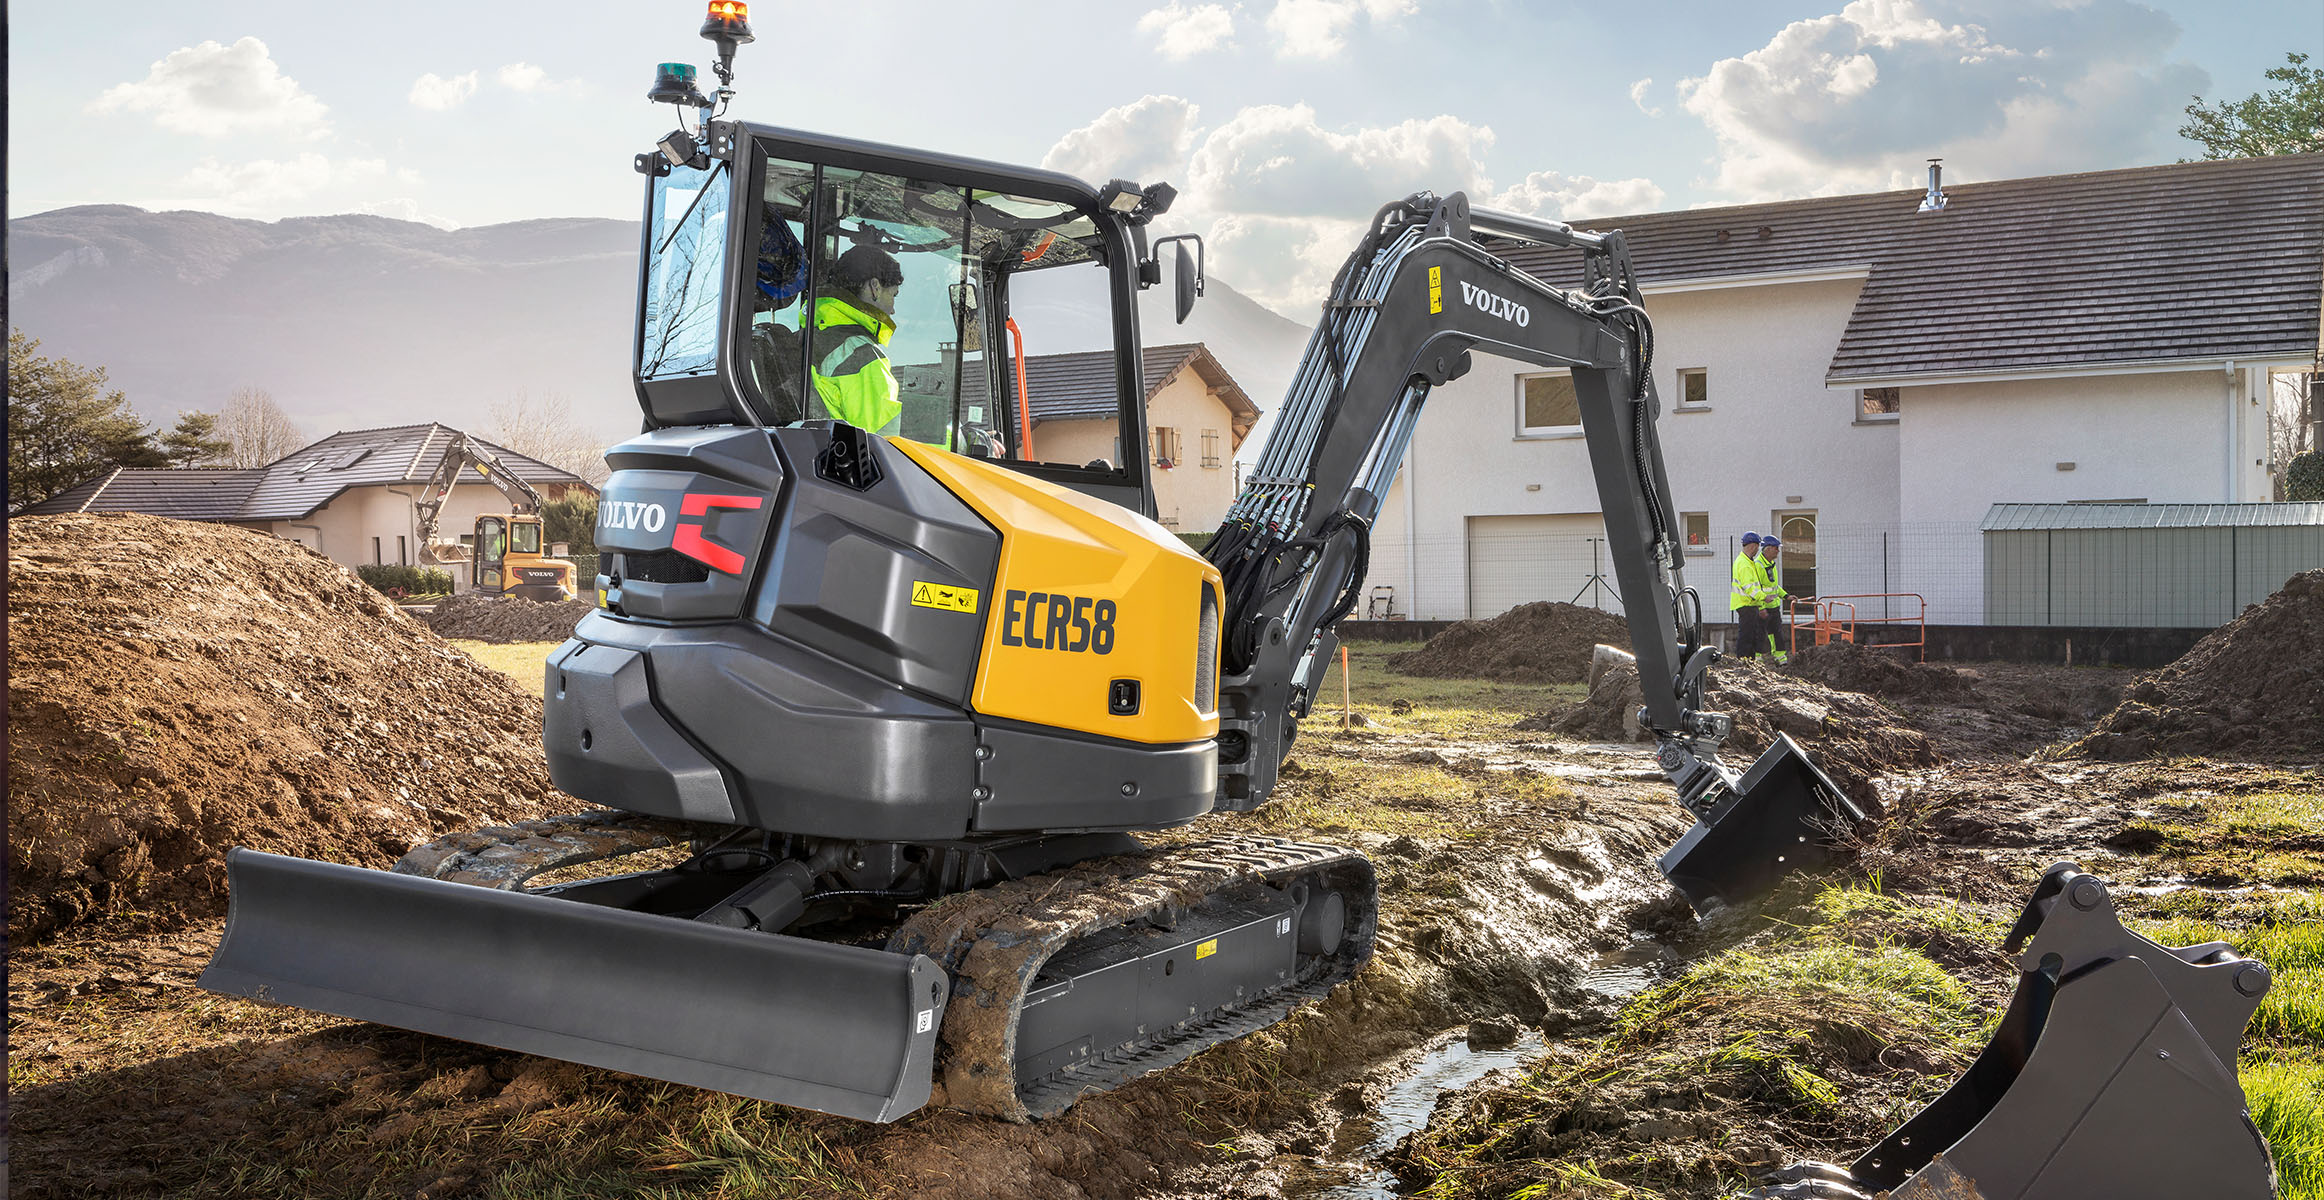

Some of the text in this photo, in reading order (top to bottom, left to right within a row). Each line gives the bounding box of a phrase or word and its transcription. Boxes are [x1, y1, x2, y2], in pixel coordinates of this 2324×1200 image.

[1460, 280, 1530, 328] VOLVO
[490, 473, 509, 491] VOLVO
[597, 500, 666, 533] VOLVO
[1002, 589, 1117, 655] ECR58
